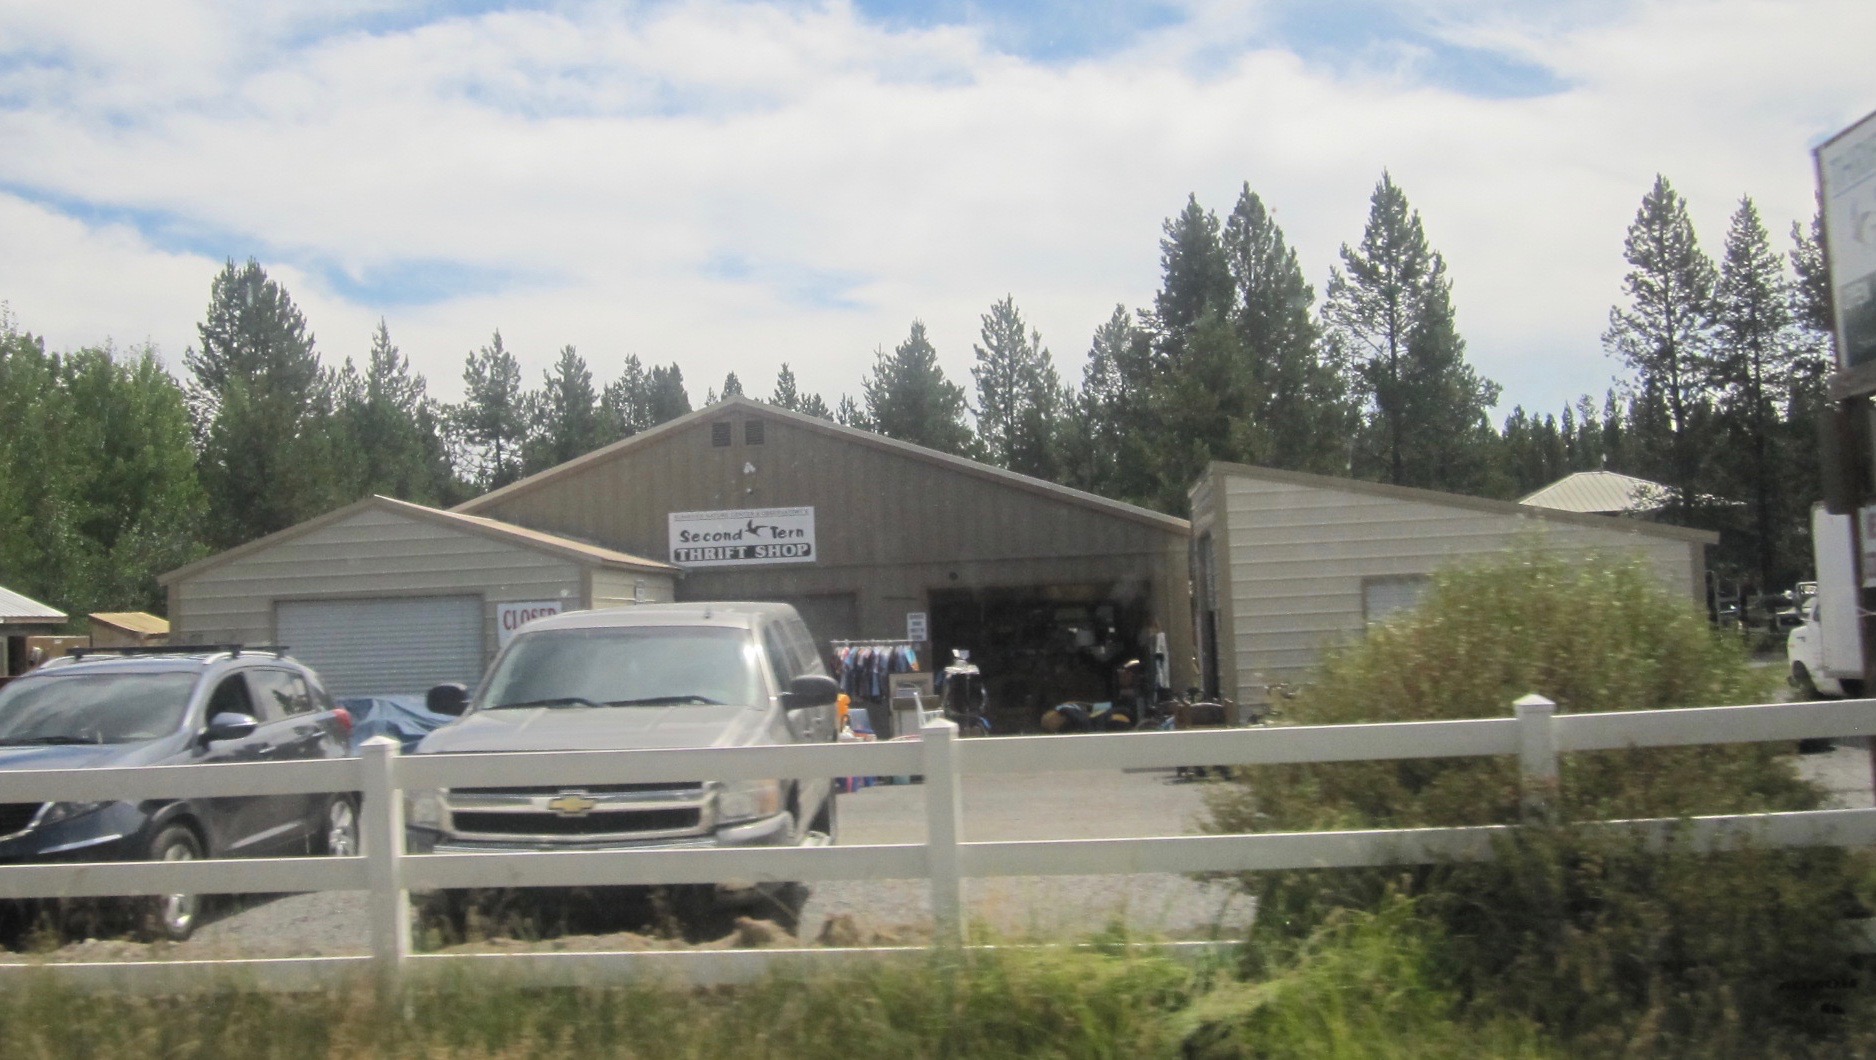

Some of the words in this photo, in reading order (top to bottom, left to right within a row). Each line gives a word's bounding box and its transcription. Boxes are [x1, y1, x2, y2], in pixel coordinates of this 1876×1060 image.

[680, 528, 743, 543] Second
[769, 525, 804, 539] Tern
[677, 546, 748, 561] THRIFT
[754, 543, 810, 558] SHOP
